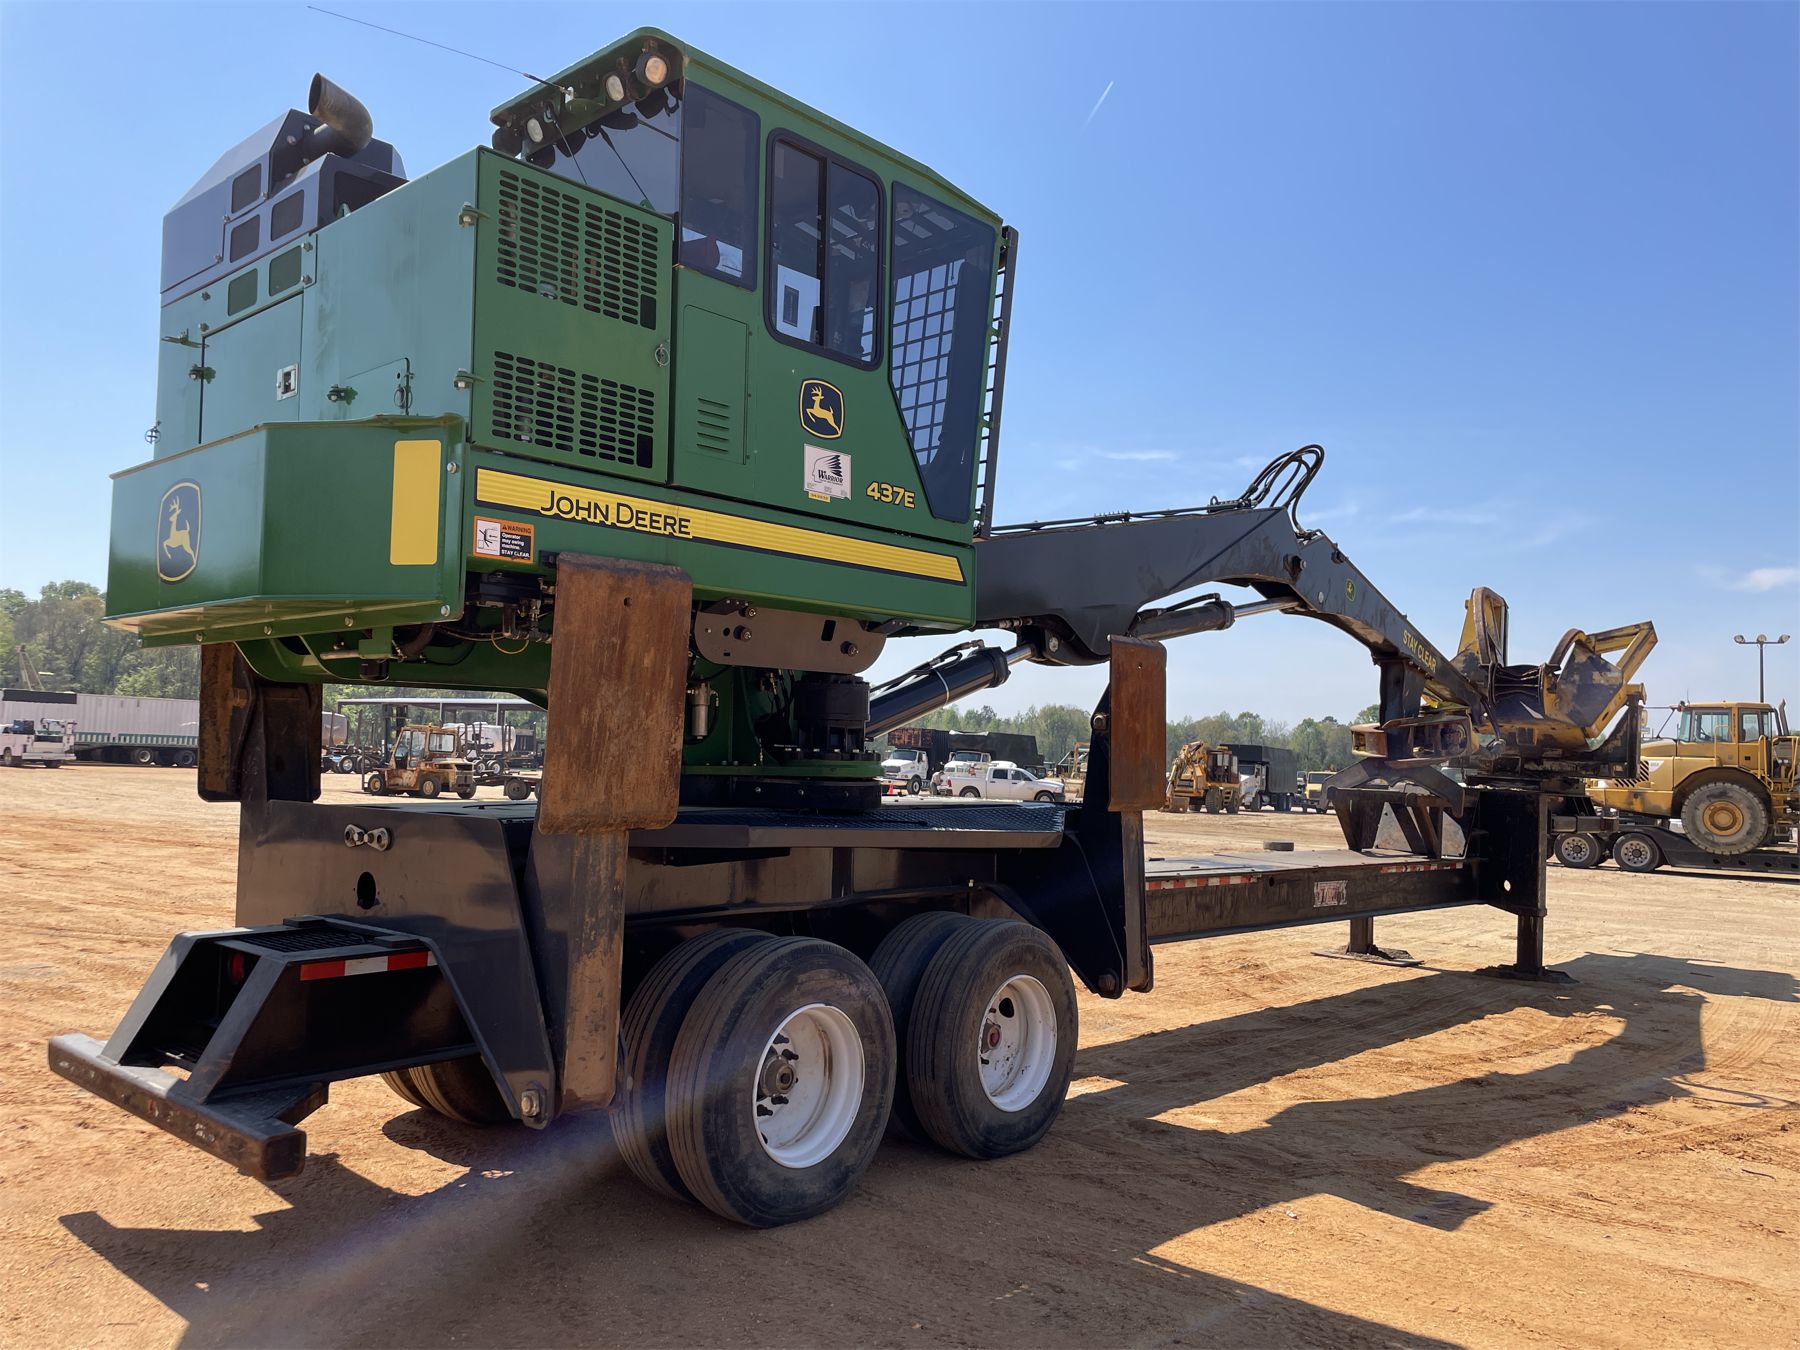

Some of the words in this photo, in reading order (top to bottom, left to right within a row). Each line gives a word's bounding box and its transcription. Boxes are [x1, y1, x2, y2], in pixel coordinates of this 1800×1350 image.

[540, 490, 609, 522] JOHN
[616, 502, 691, 535] DEERE
[866, 481, 915, 508] 437E
[1402, 630, 1418, 654] STAY
[1417, 644, 1437, 673] CLEAR
